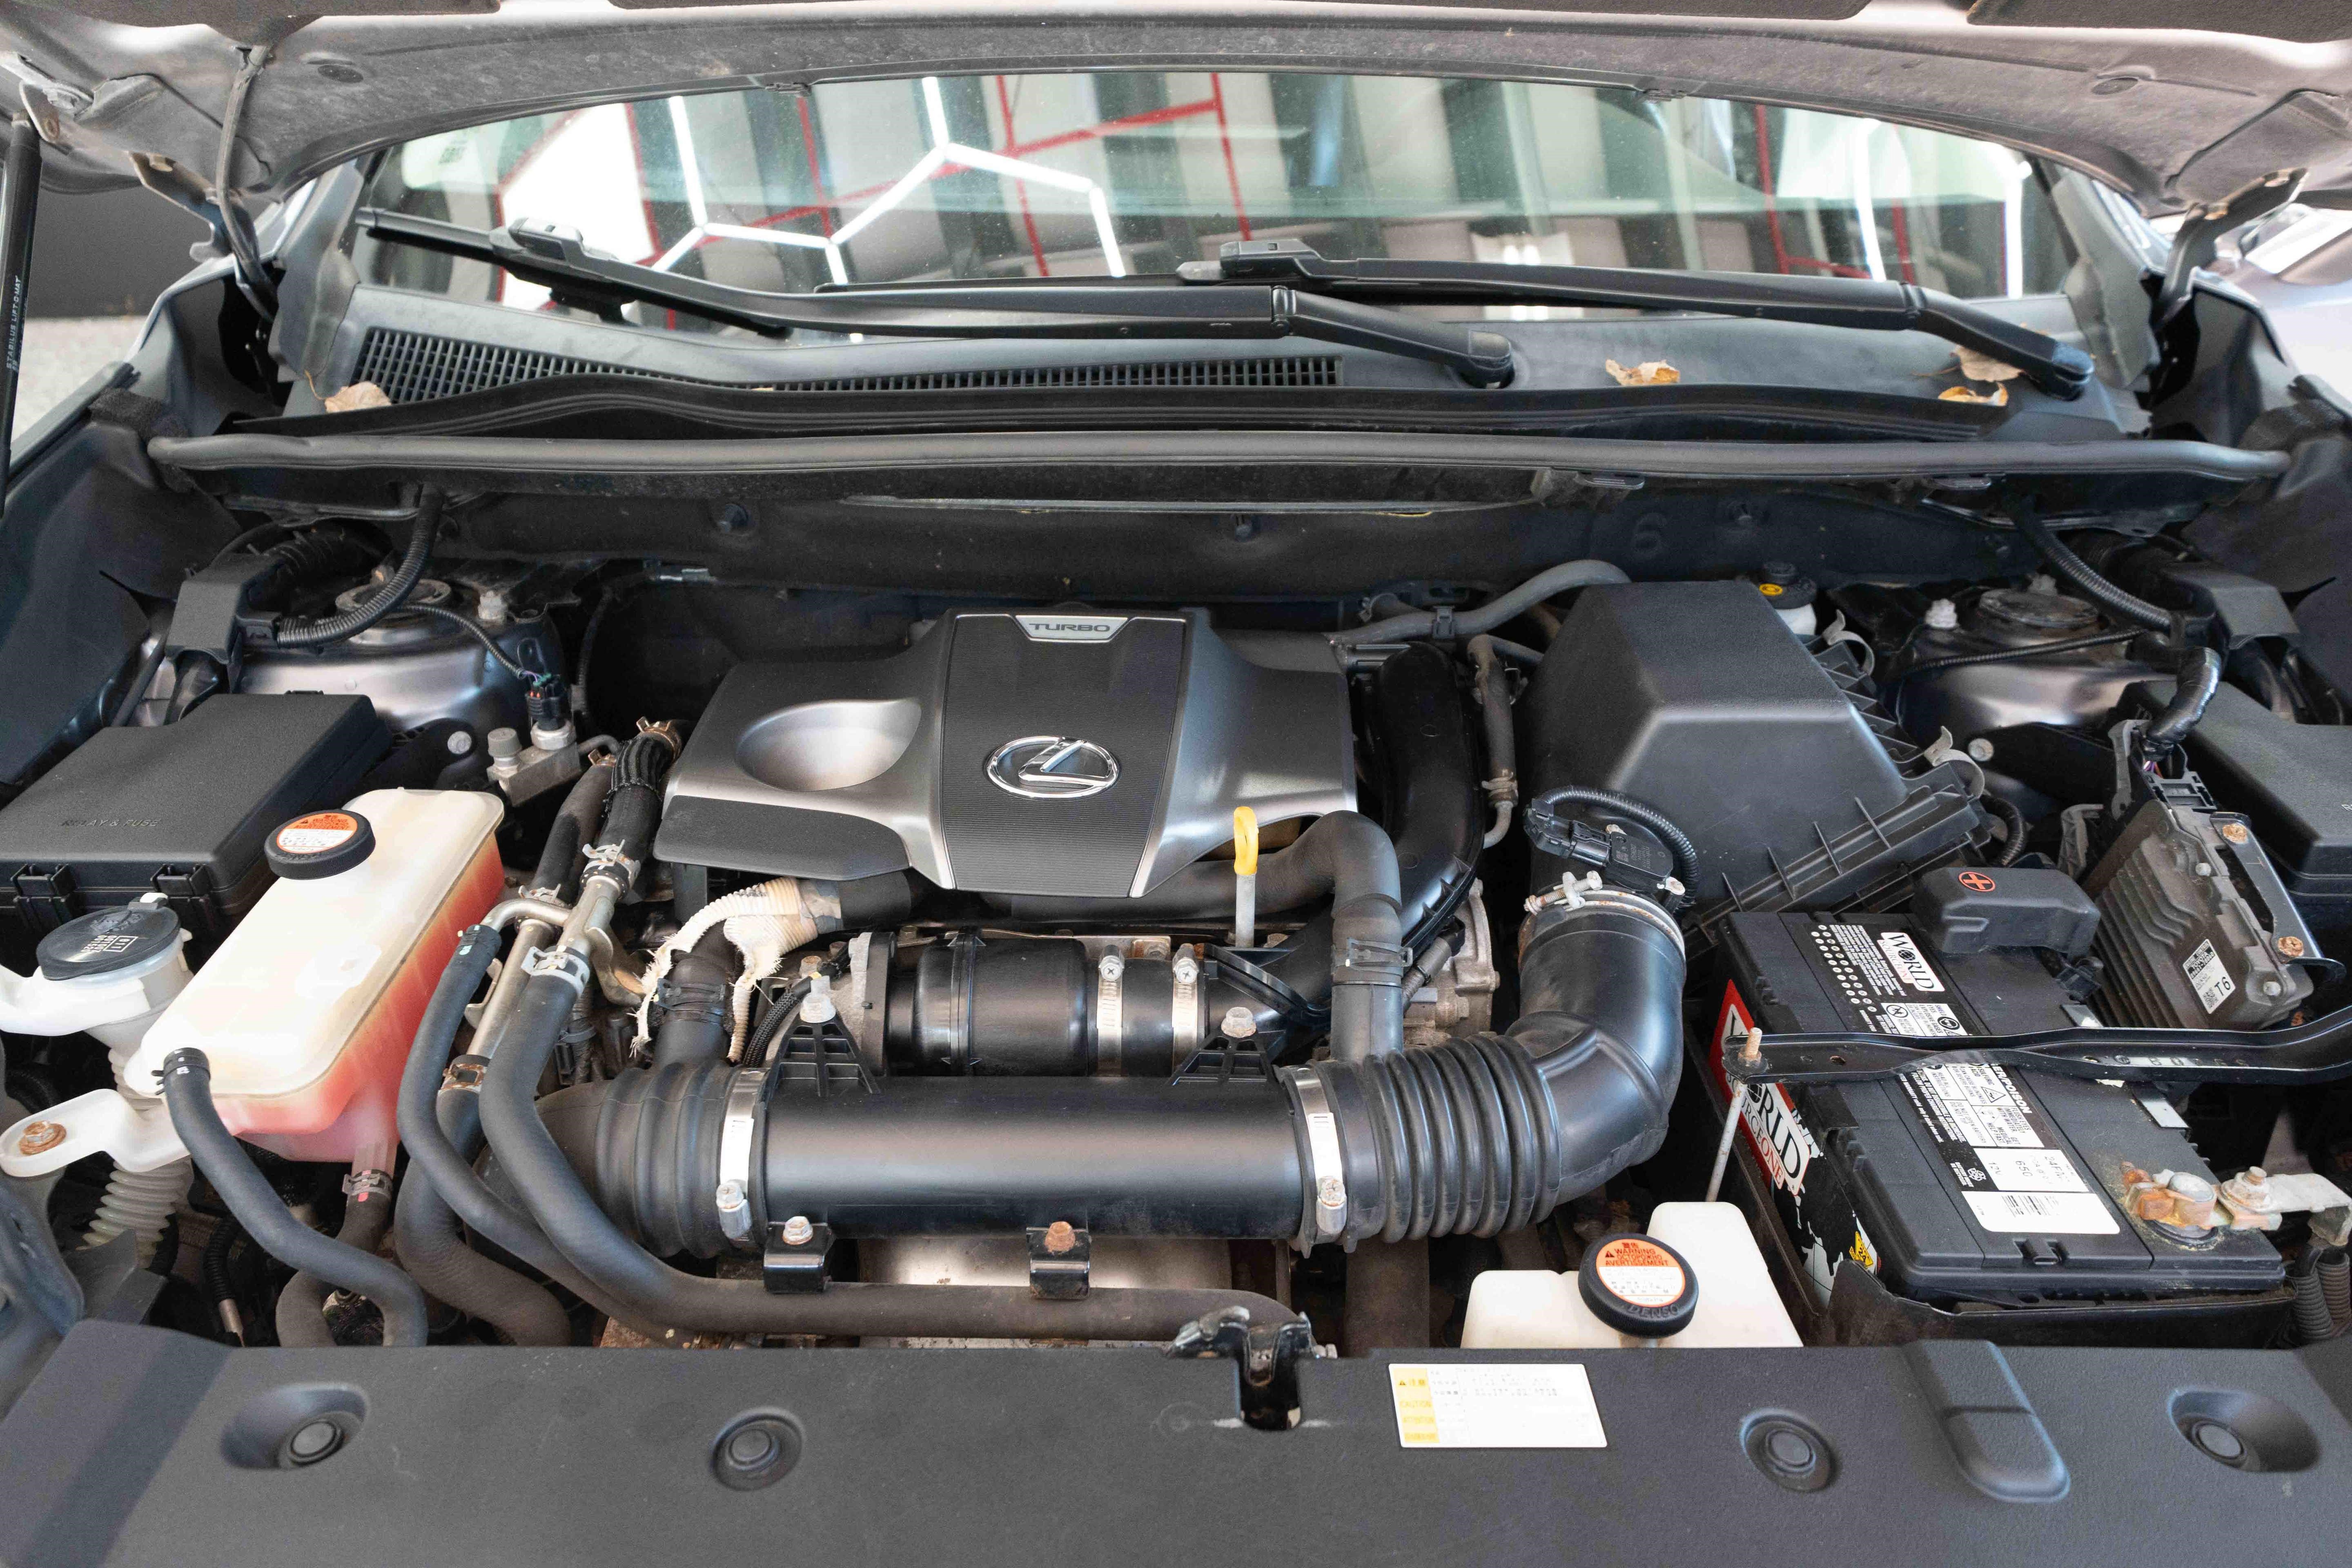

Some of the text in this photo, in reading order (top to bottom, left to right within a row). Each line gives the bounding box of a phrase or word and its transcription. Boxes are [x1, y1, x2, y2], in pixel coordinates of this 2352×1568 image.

[6, 325, 16, 369] STABILUS
[1028, 623, 1111, 633] TURBO
[1884, 934, 1939, 989] WORLD
[1919, 1004, 1943, 1033] EXPLOSIVE GASES
[1934, 1004, 1947, 1016] SHIELD
[1969, 1068, 1980, 1076] ACID
[1977, 1068, 1994, 1085] SULFURIC
[1930, 1072, 1951, 1097] INSTRUCTIONS
[1989, 1063, 2033, 1113] ER/POISON
[1996, 1107, 2009, 1117] WITH
[2003, 1107, 2026, 1133] IMMEDIATELY
[2010, 1108, 2031, 1130] FLUSH EYES
[1986, 1123, 1998, 1132] HELP
[1996, 1127, 2013, 1145] MEDICAL
[1627, 1305, 1679, 1318] DENSO
